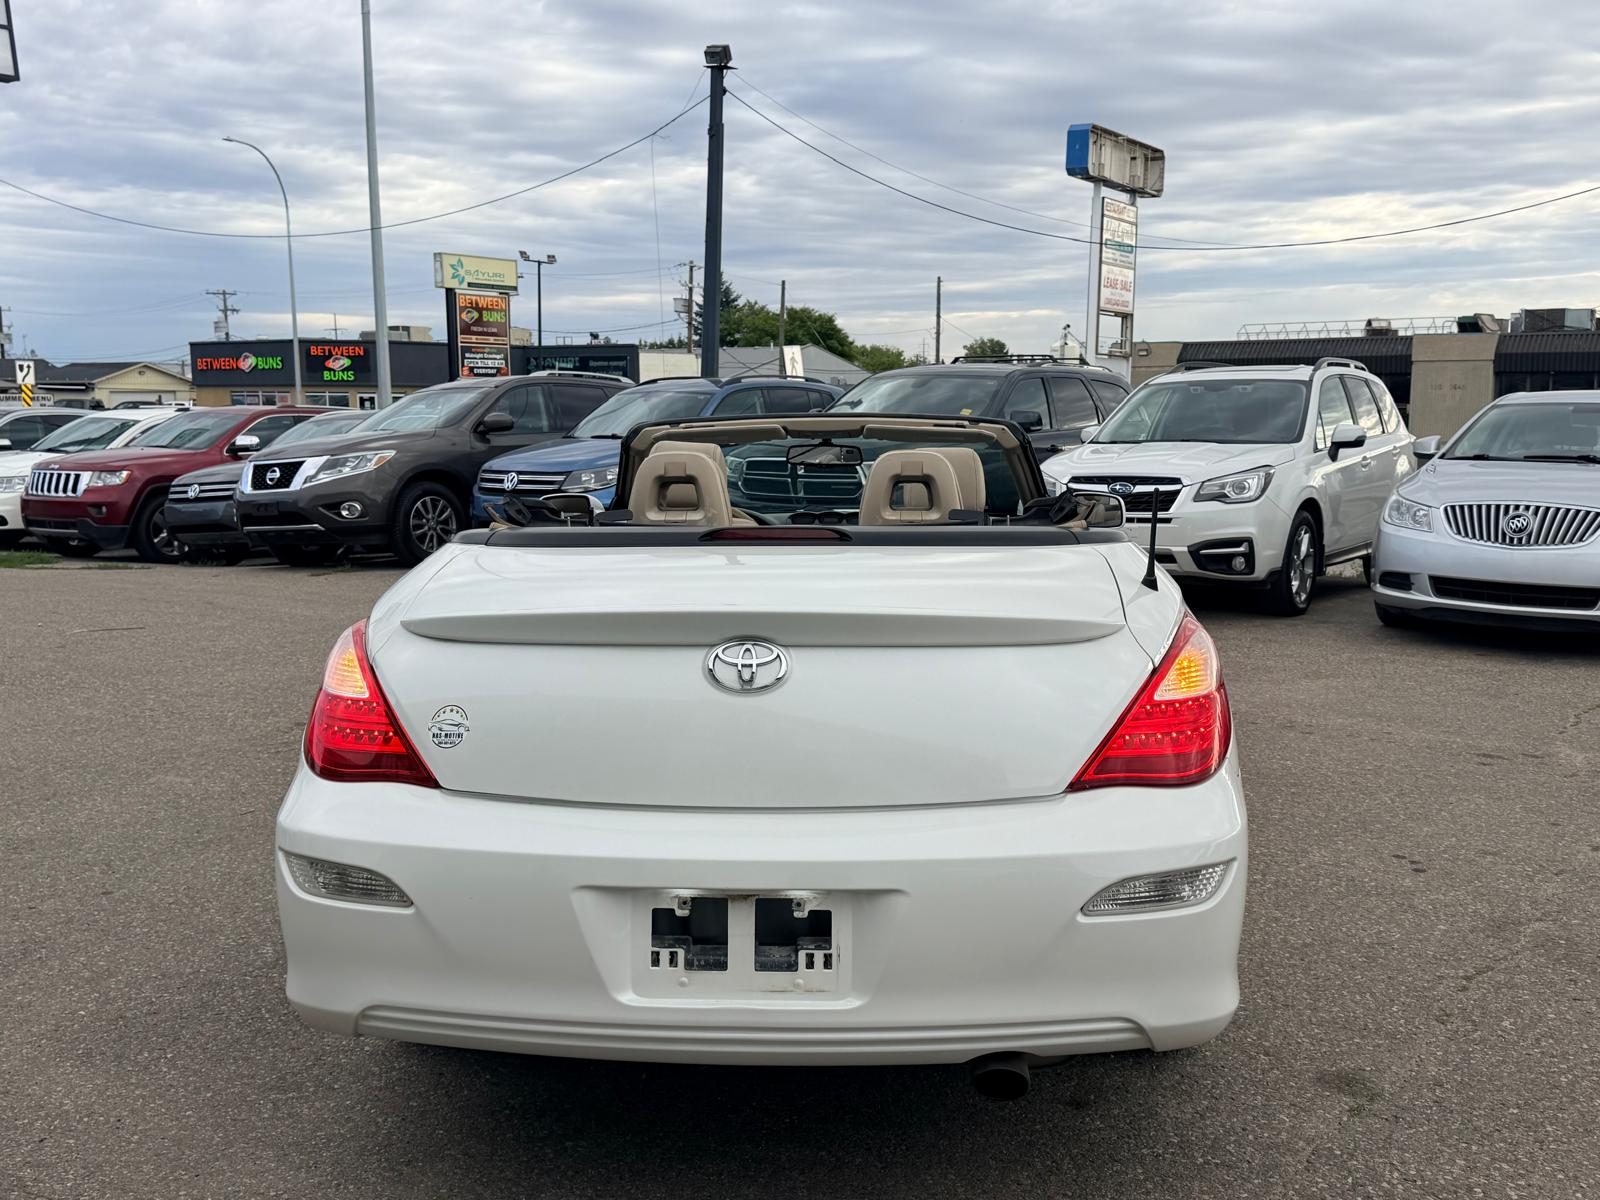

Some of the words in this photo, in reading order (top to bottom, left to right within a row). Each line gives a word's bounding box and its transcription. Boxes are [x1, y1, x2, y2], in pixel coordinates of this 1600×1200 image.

[459, 294, 506, 310] BETWEEN
[482, 310, 506, 322] BUNS
[310, 345, 364, 357] BETWEEN
[197, 357, 237, 370] BETWEEN
[257, 356, 283, 370] BUNS
[323, 370, 355, 381] BUNS
